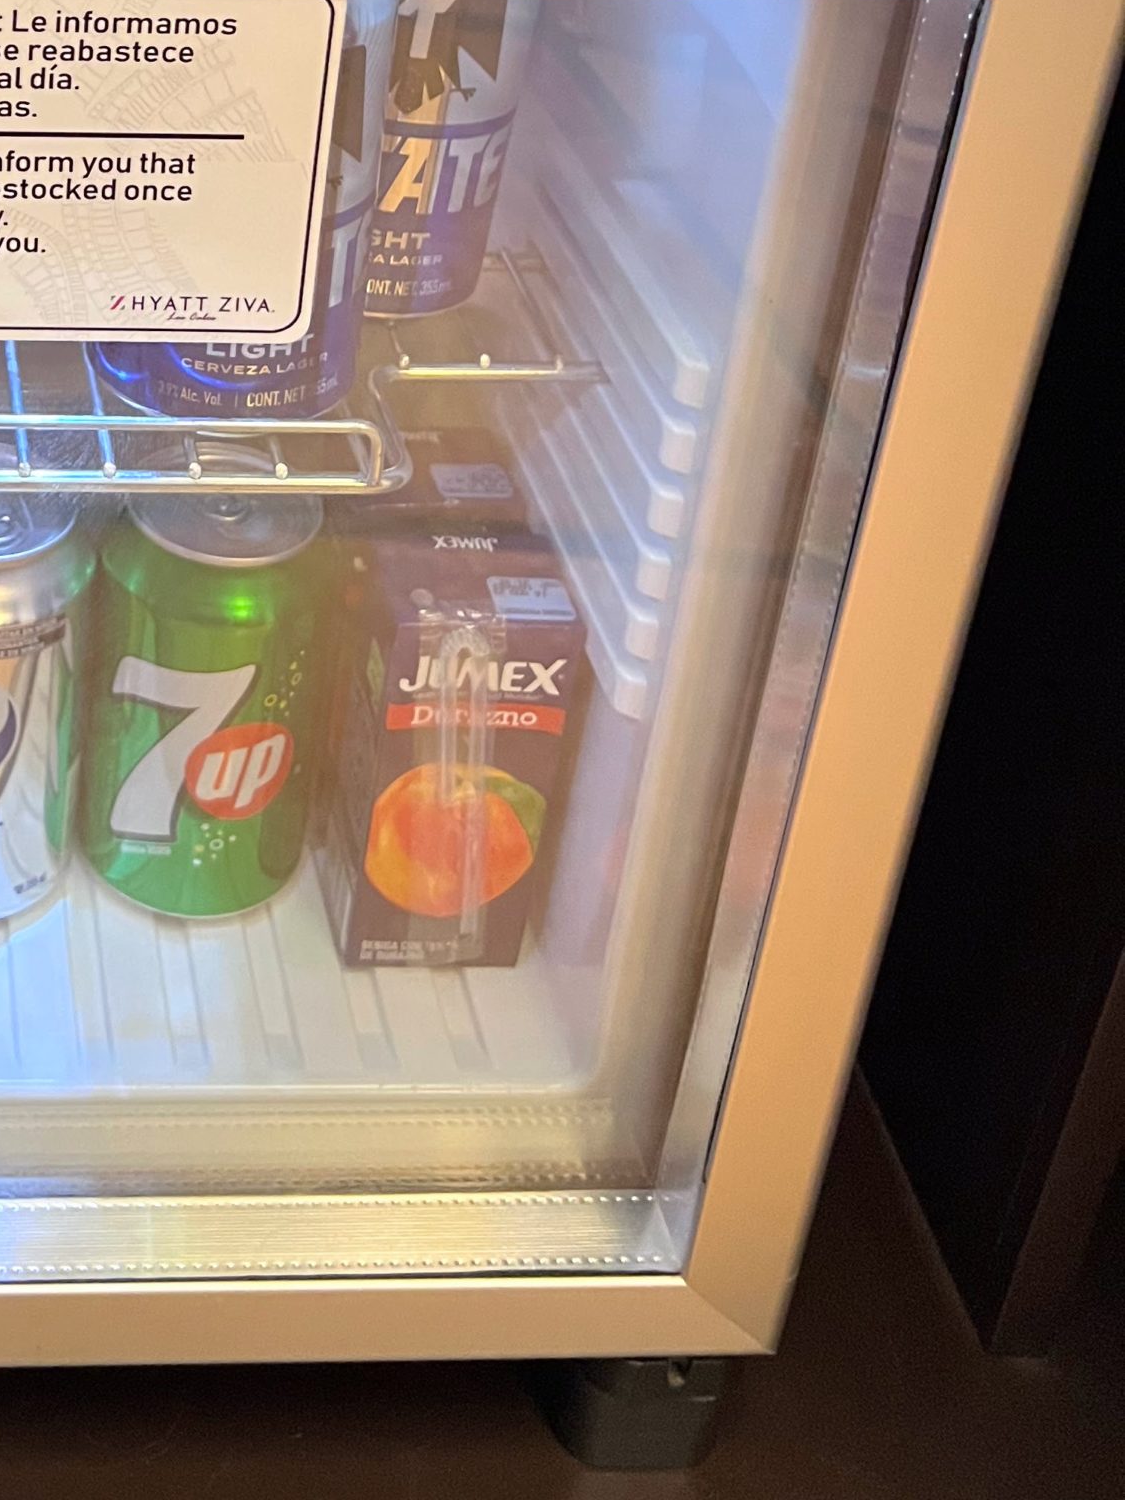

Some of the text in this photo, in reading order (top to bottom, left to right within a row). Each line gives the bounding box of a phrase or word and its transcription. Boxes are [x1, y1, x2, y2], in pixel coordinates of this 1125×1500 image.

[11, 9, 47, 33] Le
[55, 10, 237, 35] informamos
[28, 39, 194, 62] reabastece
[30, 64, 80, 90] día.
[82, 156, 132, 179] you
[139, 152, 196, 174] that
[124, 184, 192, 201] once
[366, 279, 392, 296] ONT.
[132, 296, 208, 311] HYATT
[206, 333, 315, 360] LIGHT
[180, 352, 328, 376] CERVEZA LAGER
[431, 534, 499, 552] JUMEX
[399, 655, 567, 696] JUMEX
[410, 704, 538, 728] Drzno
[111, 654, 287, 841] 7 up
